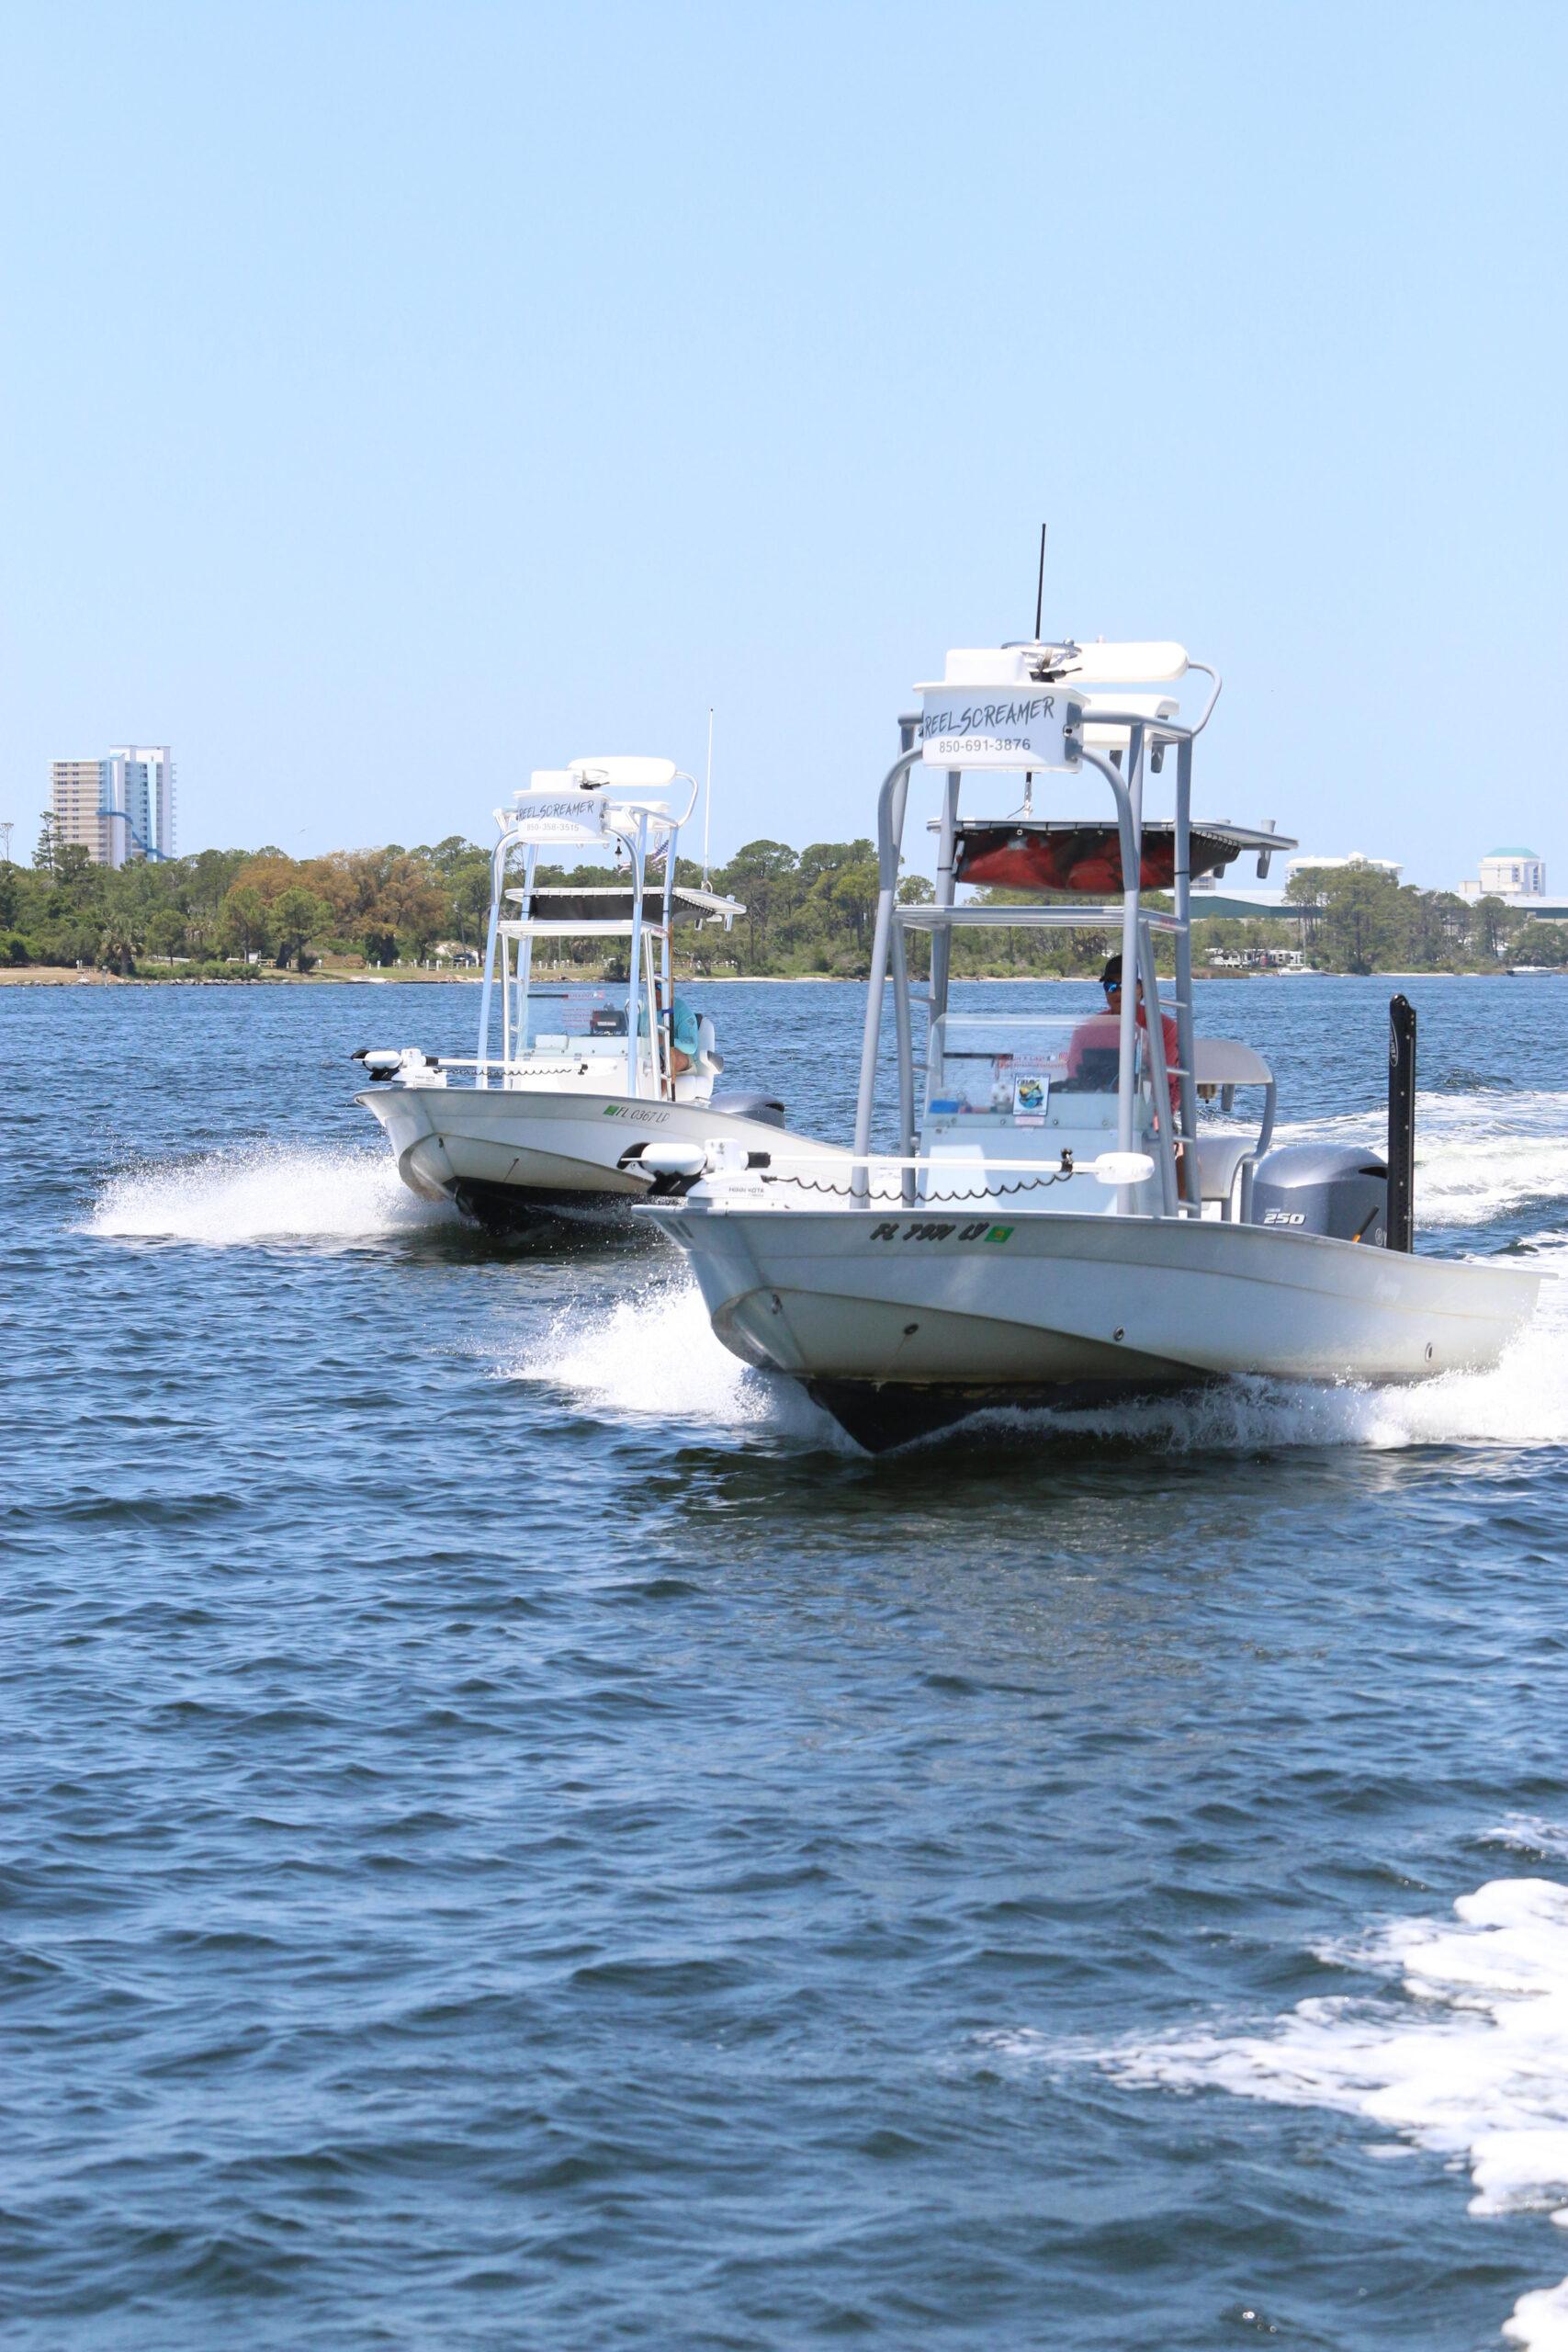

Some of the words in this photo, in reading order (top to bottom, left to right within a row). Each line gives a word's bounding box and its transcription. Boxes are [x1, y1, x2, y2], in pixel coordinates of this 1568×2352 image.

[939, 738, 1031, 753] 850-691-3876
[615, 1106, 629, 1118] FL
[1263, 1213, 1306, 1225] 250
[870, 1222, 899, 1240] FL
